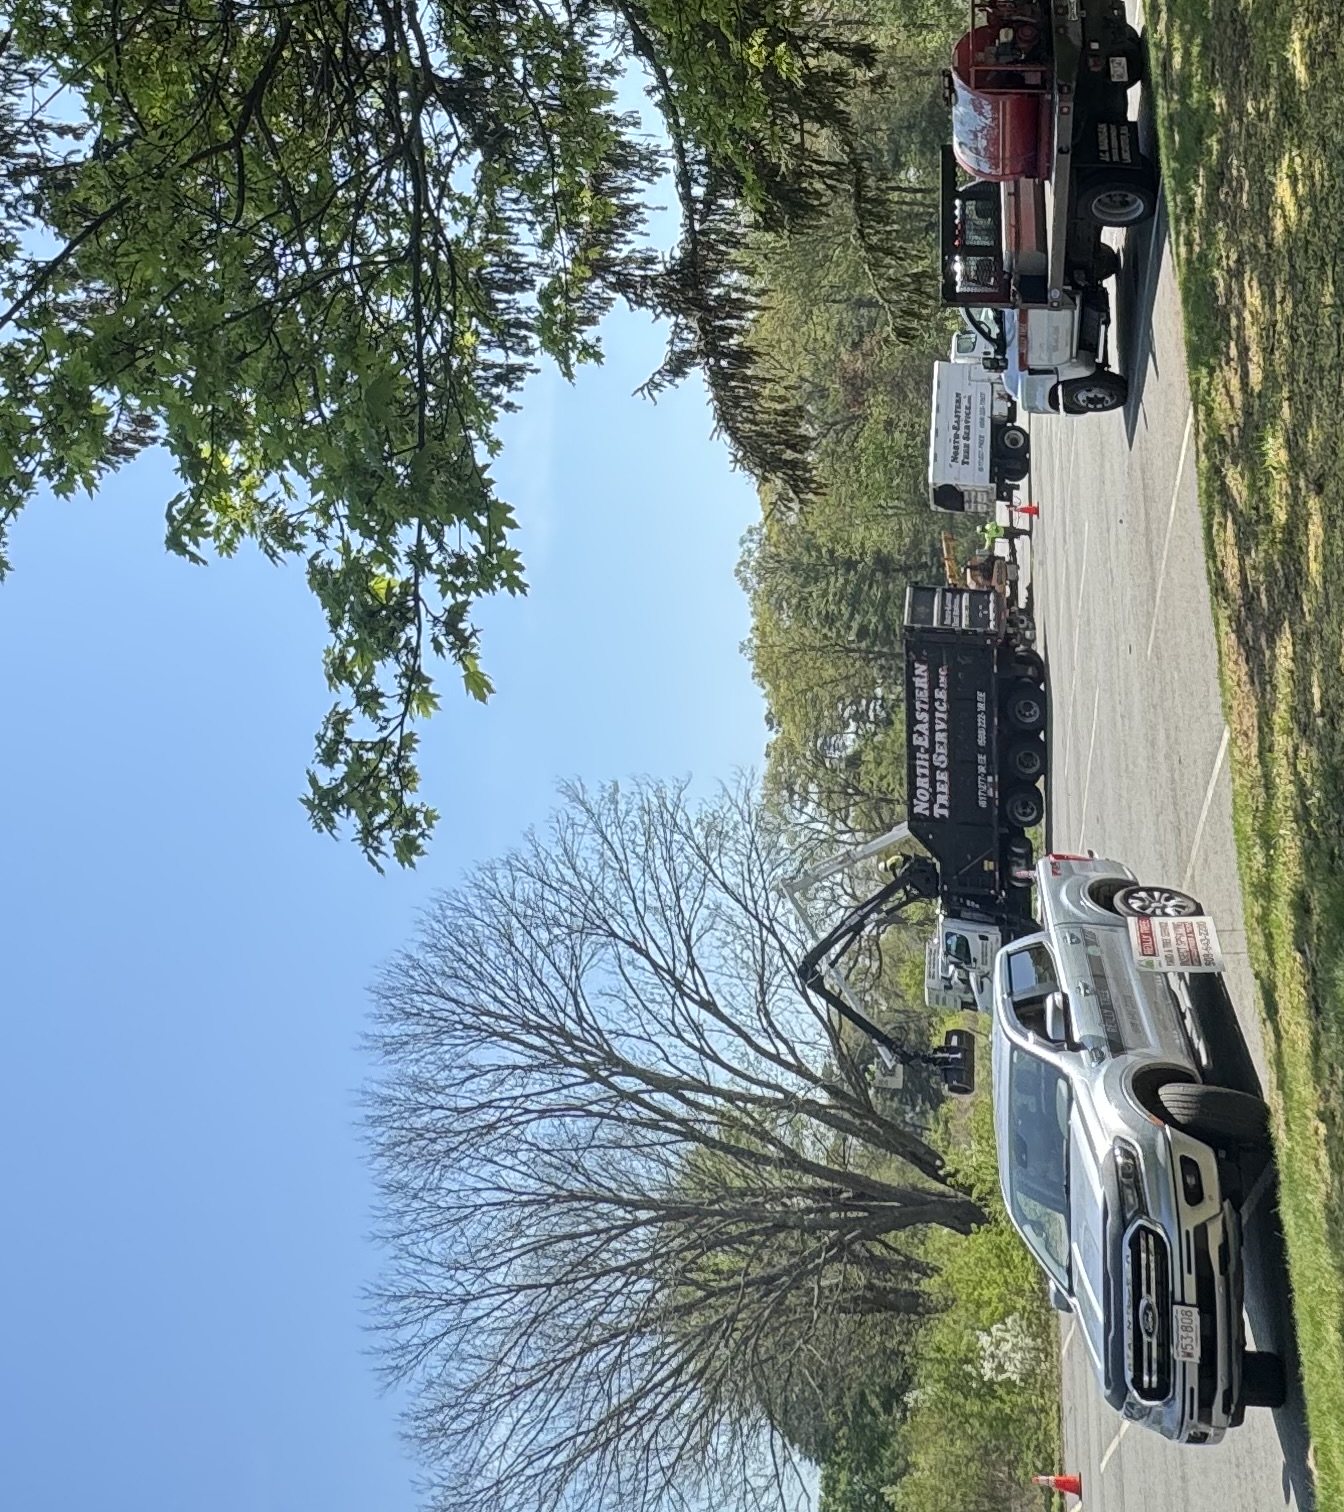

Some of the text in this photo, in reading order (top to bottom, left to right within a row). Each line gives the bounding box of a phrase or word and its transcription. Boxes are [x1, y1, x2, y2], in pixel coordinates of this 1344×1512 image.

[912, 662, 931, 816] NORTH-EASTERN
[932, 688, 948, 768] SERVICE
[933, 770, 949, 818] TREE
